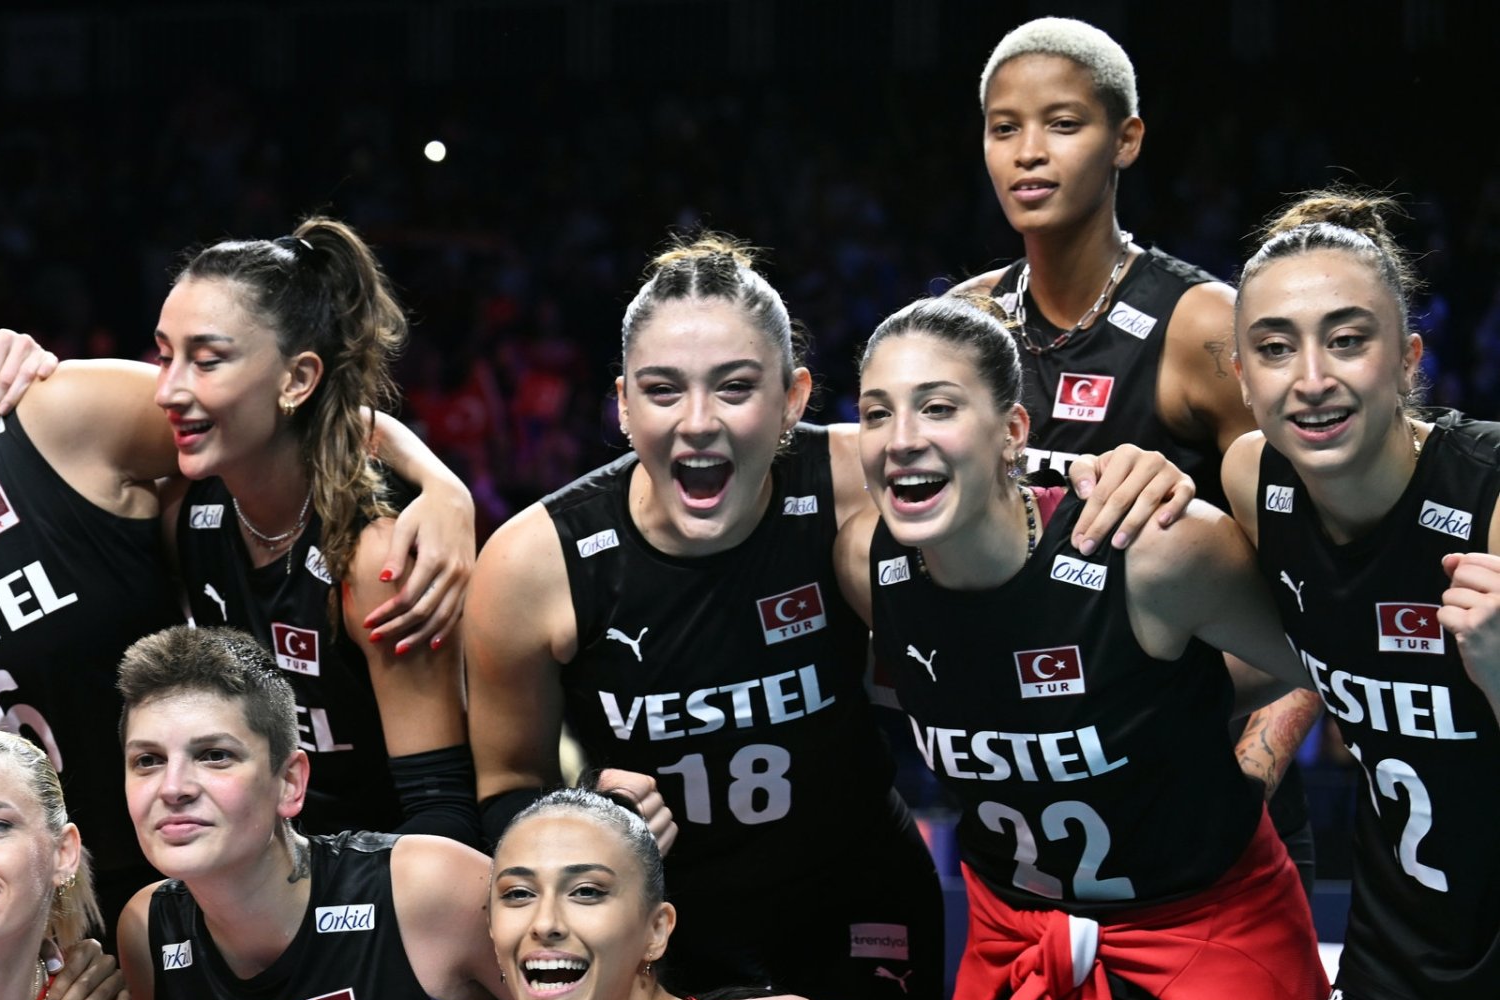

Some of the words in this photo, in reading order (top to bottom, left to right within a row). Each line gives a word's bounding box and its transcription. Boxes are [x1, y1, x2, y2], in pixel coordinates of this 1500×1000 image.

[1112, 309, 1153, 336] Orkid
[1053, 562, 1104, 590] Orkid
[779, 621, 814, 638] TUR
[1395, 639, 1430, 650] TUR
[286, 658, 310, 671] TUR
[1036, 682, 1070, 694] TUR
[598, 664, 835, 741] VESTEL
[907, 711, 1129, 782] VESTEL
[657, 743, 792, 826] 18
[978, 801, 1136, 900] 22
[319, 903, 372, 931] Orkid
